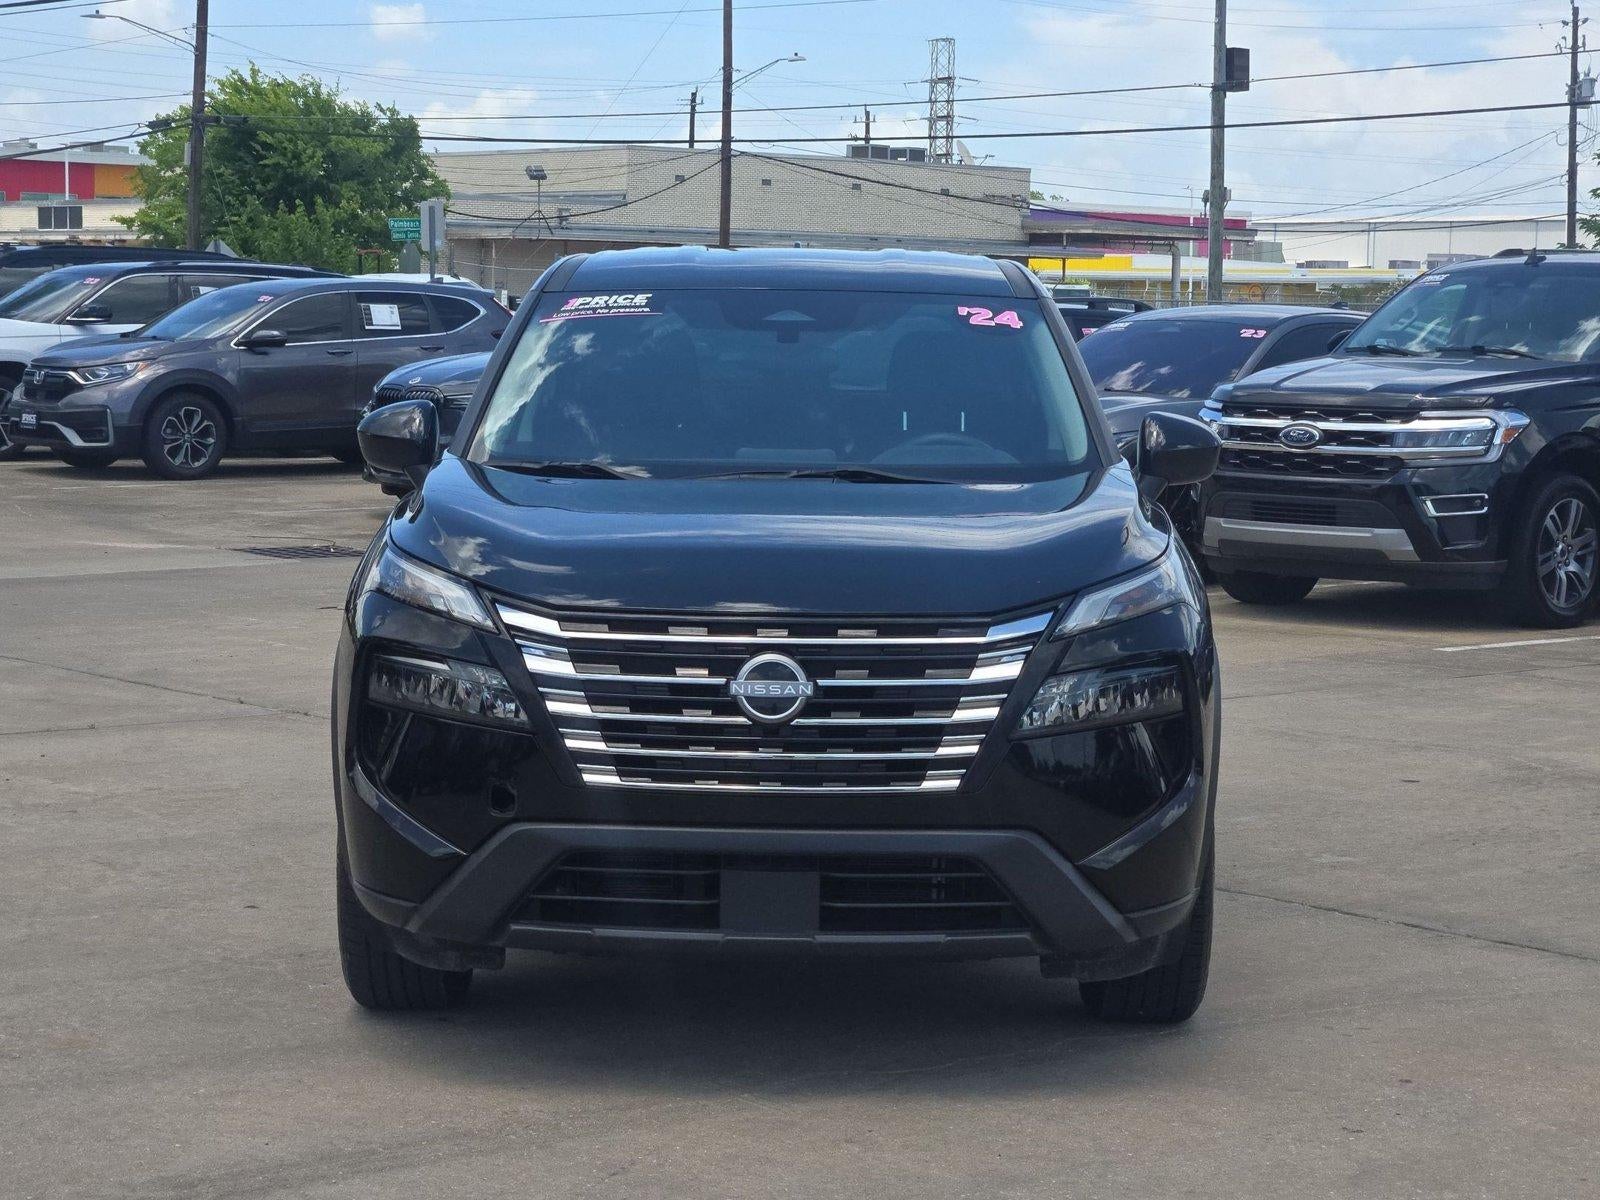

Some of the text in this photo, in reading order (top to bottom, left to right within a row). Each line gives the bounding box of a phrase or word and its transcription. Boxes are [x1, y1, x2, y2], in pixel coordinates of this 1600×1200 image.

[390, 220, 419, 228] Palmbeach
[563, 294, 652, 308] 1PRICE
[958, 306, 1023, 328] '24
[732, 683, 812, 695] NISSAN
